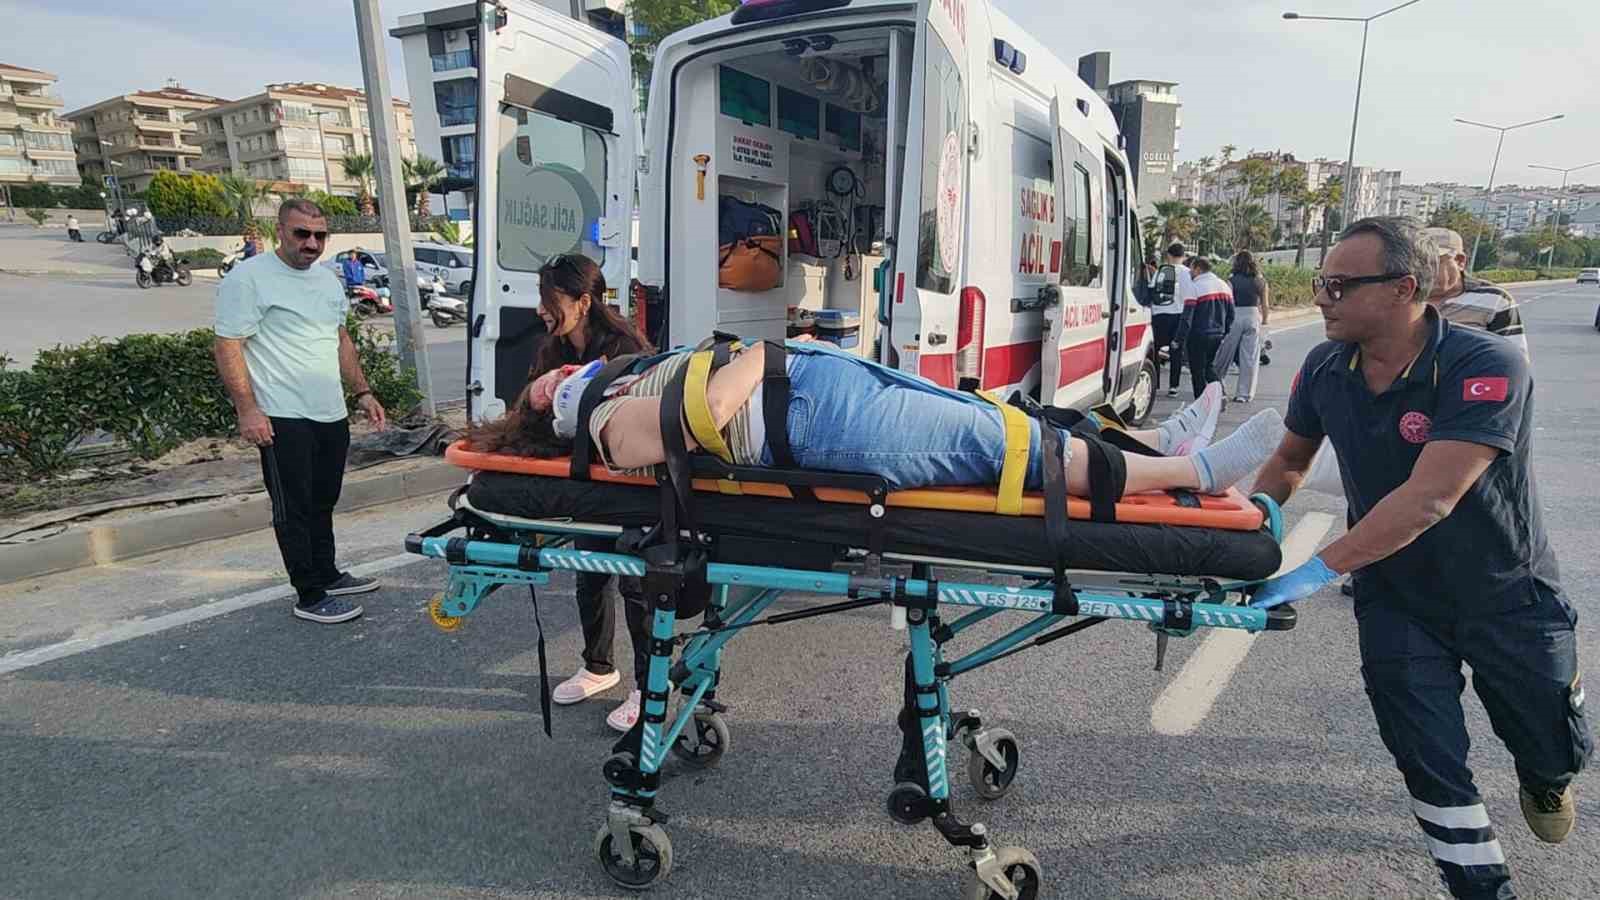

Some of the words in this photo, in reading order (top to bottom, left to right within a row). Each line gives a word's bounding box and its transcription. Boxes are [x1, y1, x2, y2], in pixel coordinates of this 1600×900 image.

[1019, 225, 1045, 274] ACİL
[985, 593, 1007, 606] ES
[1013, 596, 1039, 609] 125
[1079, 601, 1112, 615] GET
